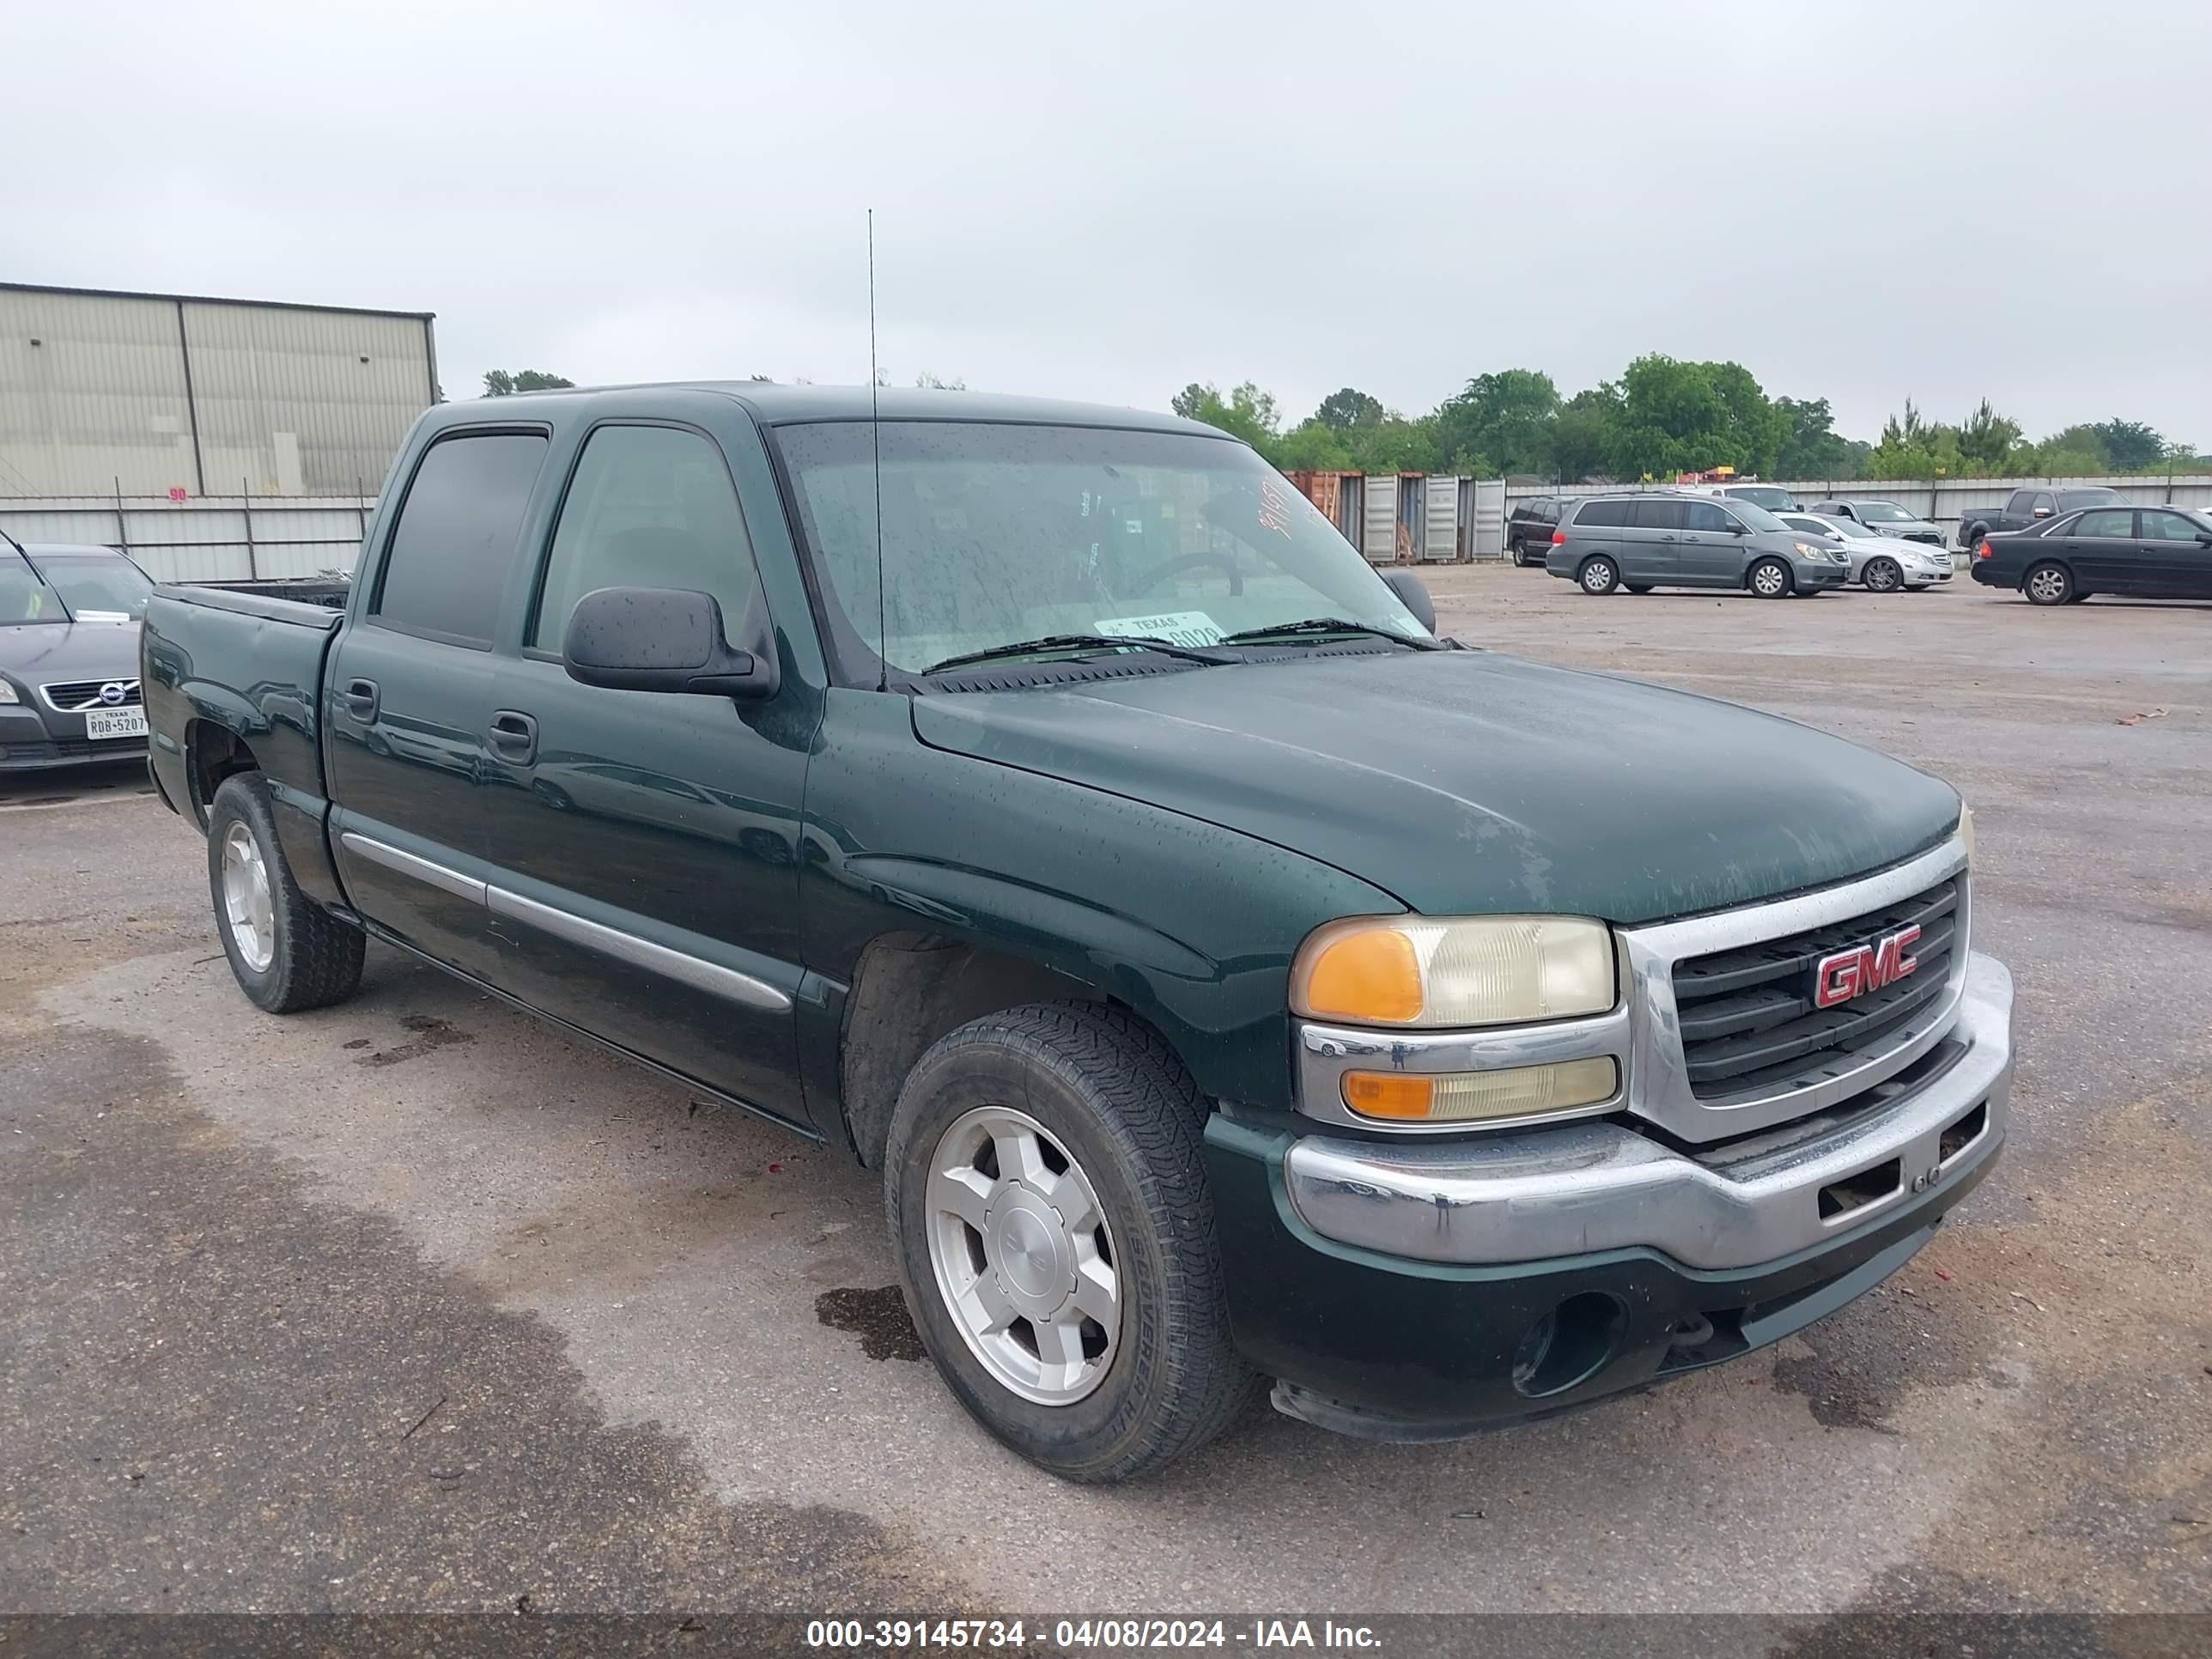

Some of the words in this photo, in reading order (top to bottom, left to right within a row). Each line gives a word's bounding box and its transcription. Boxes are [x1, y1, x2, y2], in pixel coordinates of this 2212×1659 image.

[170, 488, 186, 501] 90
[1132, 617, 1180, 631] TEXAS
[1814, 924, 1922, 1009] GMC
